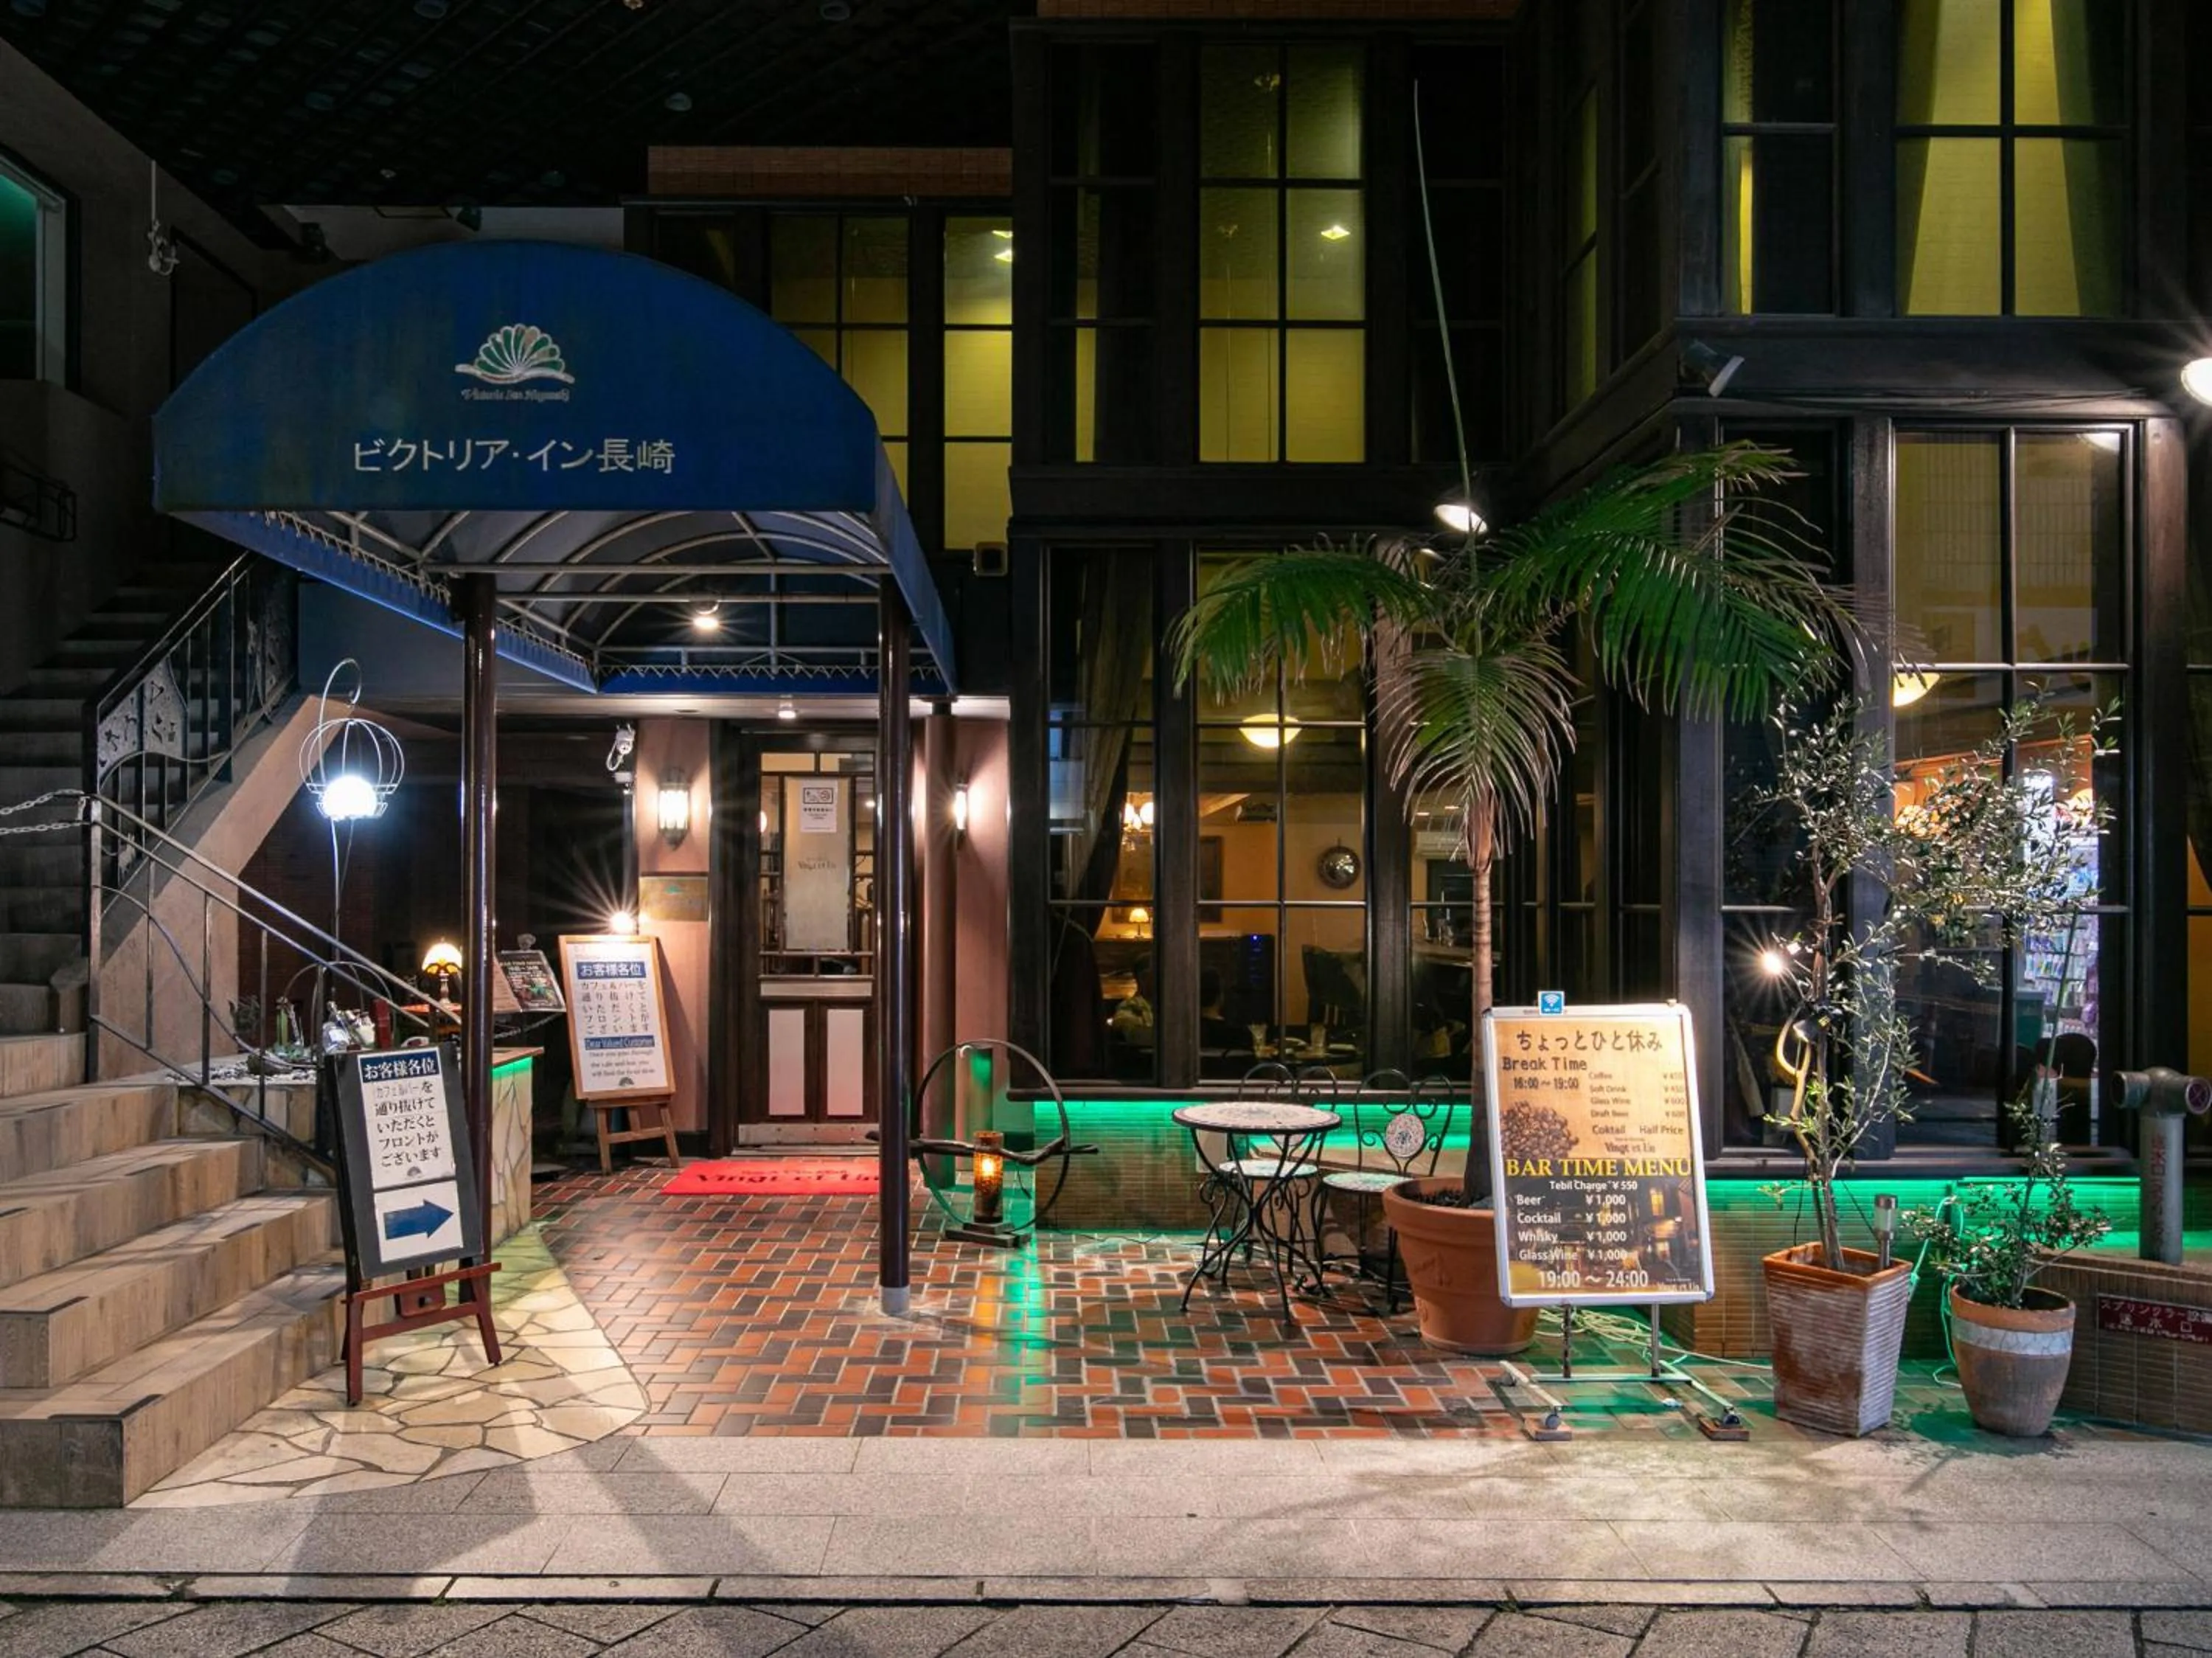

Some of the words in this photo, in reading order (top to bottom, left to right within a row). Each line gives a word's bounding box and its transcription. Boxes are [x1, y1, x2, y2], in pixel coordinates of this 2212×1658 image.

[354, 439, 675, 474] ビクトリア・イン長崎
[580, 964, 643, 977] お客様各位
[1517, 1030, 1663, 1052] ちょっとひと休み
[364, 1058, 436, 1079] お客様各位
[1502, 1056, 1546, 1071] Break
[1551, 1056, 1587, 1071] Time
[375, 1097, 435, 1116] 通り抜けて
[378, 1115, 435, 1133] いただくと
[1639, 1125, 1658, 1134] Half
[1660, 1125, 1683, 1134] Price
[379, 1131, 439, 1149] フロントが
[381, 1146, 441, 1167] ございます
[1506, 1159, 1553, 1176] BAR
[1559, 1159, 1618, 1176] TIME
[1624, 1159, 1691, 1176] MENU
[1517, 1196, 1542, 1205] Beer
[1517, 1213, 1561, 1224] Cocktail
[1518, 1231, 1558, 1244] Whisky
[1519, 1250, 1548, 1260] Glass
[1549, 1249, 1579, 1260] Wine
